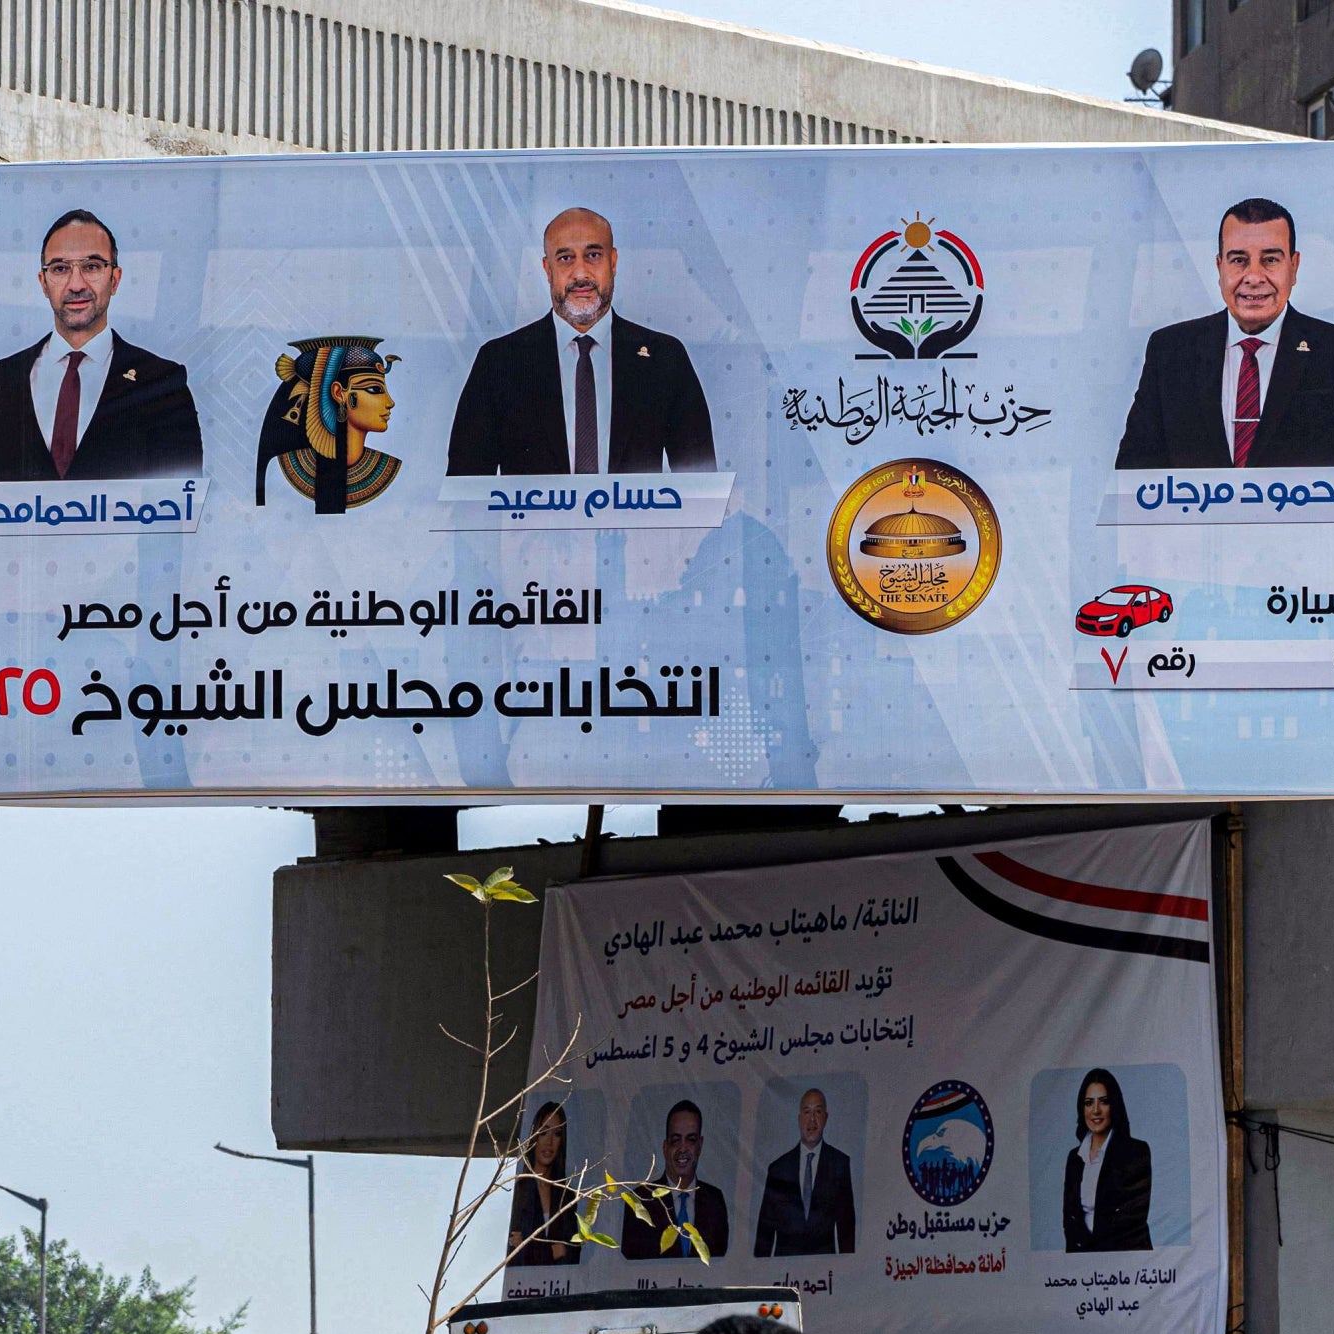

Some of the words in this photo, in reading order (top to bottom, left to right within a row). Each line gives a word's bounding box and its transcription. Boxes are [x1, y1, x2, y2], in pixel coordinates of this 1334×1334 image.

[781, 374, 890, 446] الوطنية
[890, 366, 964, 437] الجبهة
[863, 484, 873, 494] OF
[872, 471, 896, 487] EGYPT
[1137, 476, 1234, 513] مرجان
[113, 480, 195, 524] أحمد
[488, 490, 576, 510] سعيد
[585, 482, 681, 517] حسام
[879, 562, 920, 593] الشيوخ
[907, 562, 949, 593] مجلس
[150, 576, 230, 641] أجل
[306, 590, 458, 637] الوطنية
[469, 582, 601, 629] القائمة
[879, 594, 902, 603] THE
[905, 594, 949, 603] SENATE
[58, 604, 142, 641] مصر
[237, 602, 297, 634] من
[1100, 646, 1128, 685] ٧
[1147, 647, 1196, 678] رقم
[72, 659, 282, 736] الشيوخ
[296, 670, 483, 736] مجلس
[494, 666, 719, 733] انتخابات
[710, 919, 762, 942] محمد
[769, 905, 847, 947] ماهيتاب
[854, 896, 919, 937] النائبة/
[604, 920, 664, 966] الهادي
[670, 925, 703, 955] عبد
[661, 974, 696, 1013] أجل
[729, 974, 788, 1010] الوطنيه
[794, 969, 850, 996] القائمه
[855, 967, 892, 998] تؤيد
[618, 994, 656, 1018] مصر
[700, 988, 723, 1011] من
[662, 1036, 673, 1058] 5
[696, 1033, 708, 1057] 4
[713, 1027, 775, 1065] الشيوخ
[779, 1024, 834, 1056] مجلس
[840, 1015, 914, 1051] إنتخابات
[586, 1036, 656, 1068] اغسطس
[678, 1041, 691, 1063] و
[886, 1212, 917, 1240] وطن
[918, 1212, 975, 1240] مستقبل
[978, 1212, 1011, 1239] حزب
[885, 1256, 923, 1281] الجيزة
[926, 1255, 975, 1276] محافظة
[978, 1249, 1006, 1273] أمانة
[804, 1270, 833, 1295] أحمد
[1044, 1277, 1077, 1289] محمد
[1082, 1272, 1131, 1291] ماهيتاب
[1134, 1269, 1176, 1290] النائبة/
[1076, 1297, 1114, 1320] الهادي
[1117, 1300, 1140, 1318] عبد
